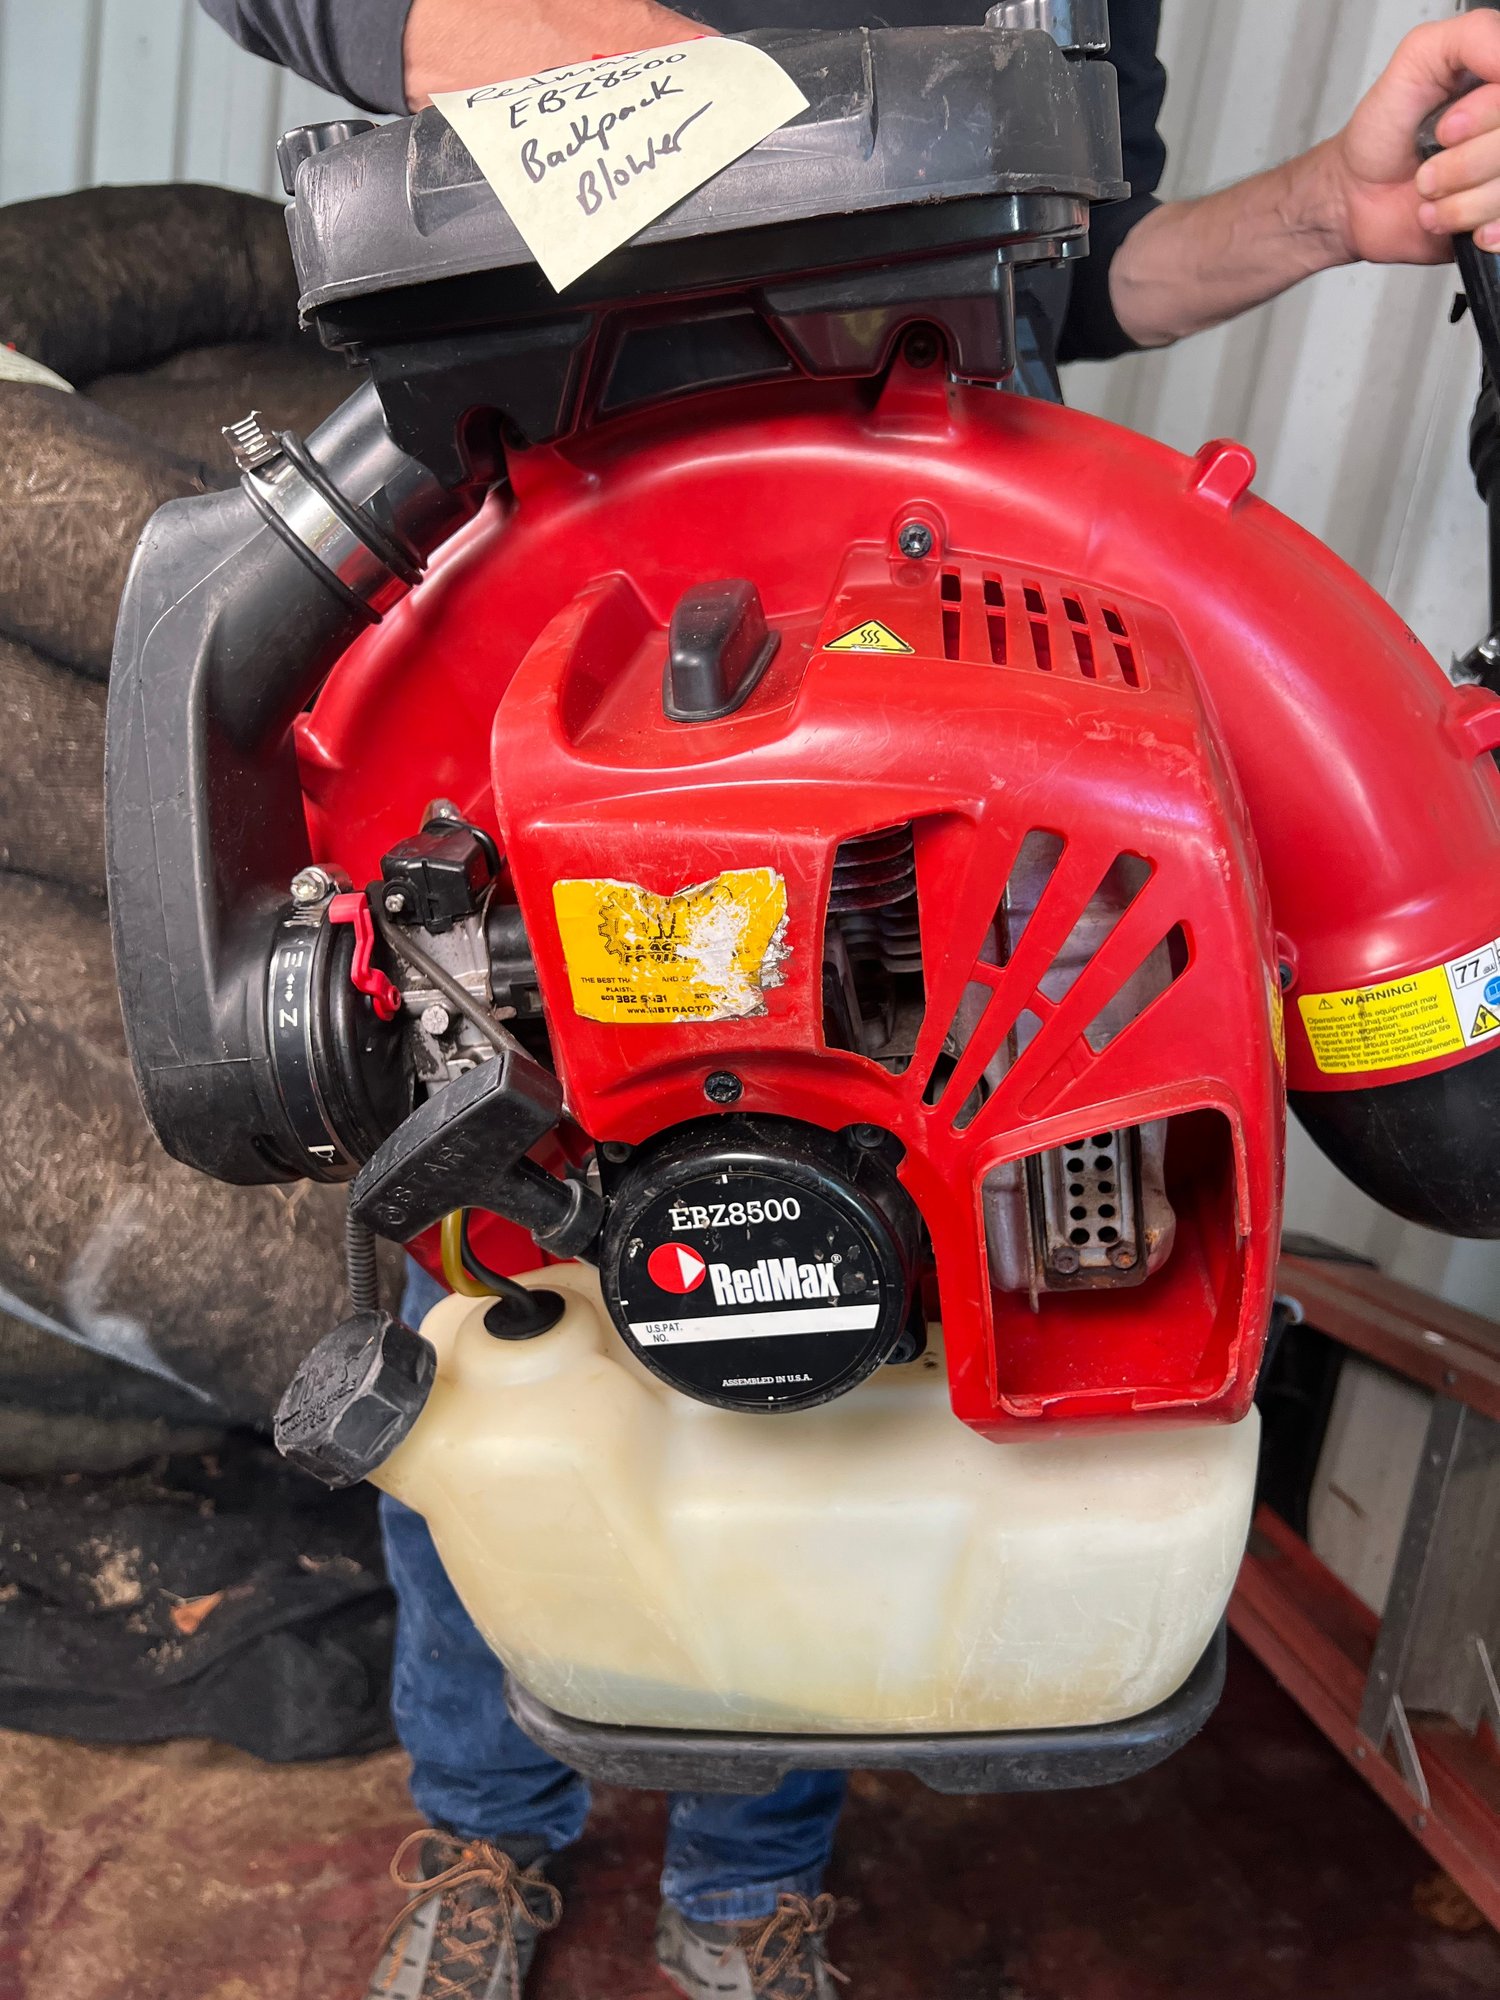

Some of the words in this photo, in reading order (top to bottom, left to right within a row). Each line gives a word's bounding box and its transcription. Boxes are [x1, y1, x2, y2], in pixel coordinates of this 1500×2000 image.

[510, 53, 687, 128] EBZ8500
[521, 76, 684, 183] Backpack
[576, 101, 713, 216] Blower
[1455, 959, 1481, 984] 77
[616, 995, 637, 1003] 382
[1341, 981, 1419, 1006] WARNING!
[1307, 1015, 1346, 1025] Operation
[1347, 1013, 1356, 1021] of
[1374, 1000, 1418, 1017] equipment
[1420, 994, 1438, 1005] may
[1309, 1024, 1334, 1032] create
[1336, 1021, 1363, 1031] sparks
[1383, 1014, 1398, 1023] can
[1400, 1008, 1419, 1018] start
[1421, 1003, 1439, 1014] fires
[1312, 1031, 1339, 1039] around
[1341, 1029, 1354, 1038] dry
[1322, 1038, 1342, 1047] spark
[1378, 1030, 1396, 1040] may
[1398, 1027, 1409, 1036] be
[1411, 1016, 1447, 1032] required.
[1331, 1045, 1361, 1054] operator
[1390, 1034, 1418, 1045] contact
[1420, 1028, 1437, 1038] local
[1439, 1024, 1451, 1033] fire
[1318, 1053, 1350, 1062] agencies
[1392, 1038, 1433, 1053] regulations
[1320, 1060, 1347, 1069] relating
[1370, 1052, 1410, 1065] prevention
[668, 1197, 802, 1231] EBZ8500
[708, 1257, 841, 1306] RedMax
[653, 1334, 670, 1344] NO.
[722, 1375, 774, 1387] ASSEMBLED
[775, 1375, 787, 1384] IN
[787, 1373, 813, 1383] U.S.A.
